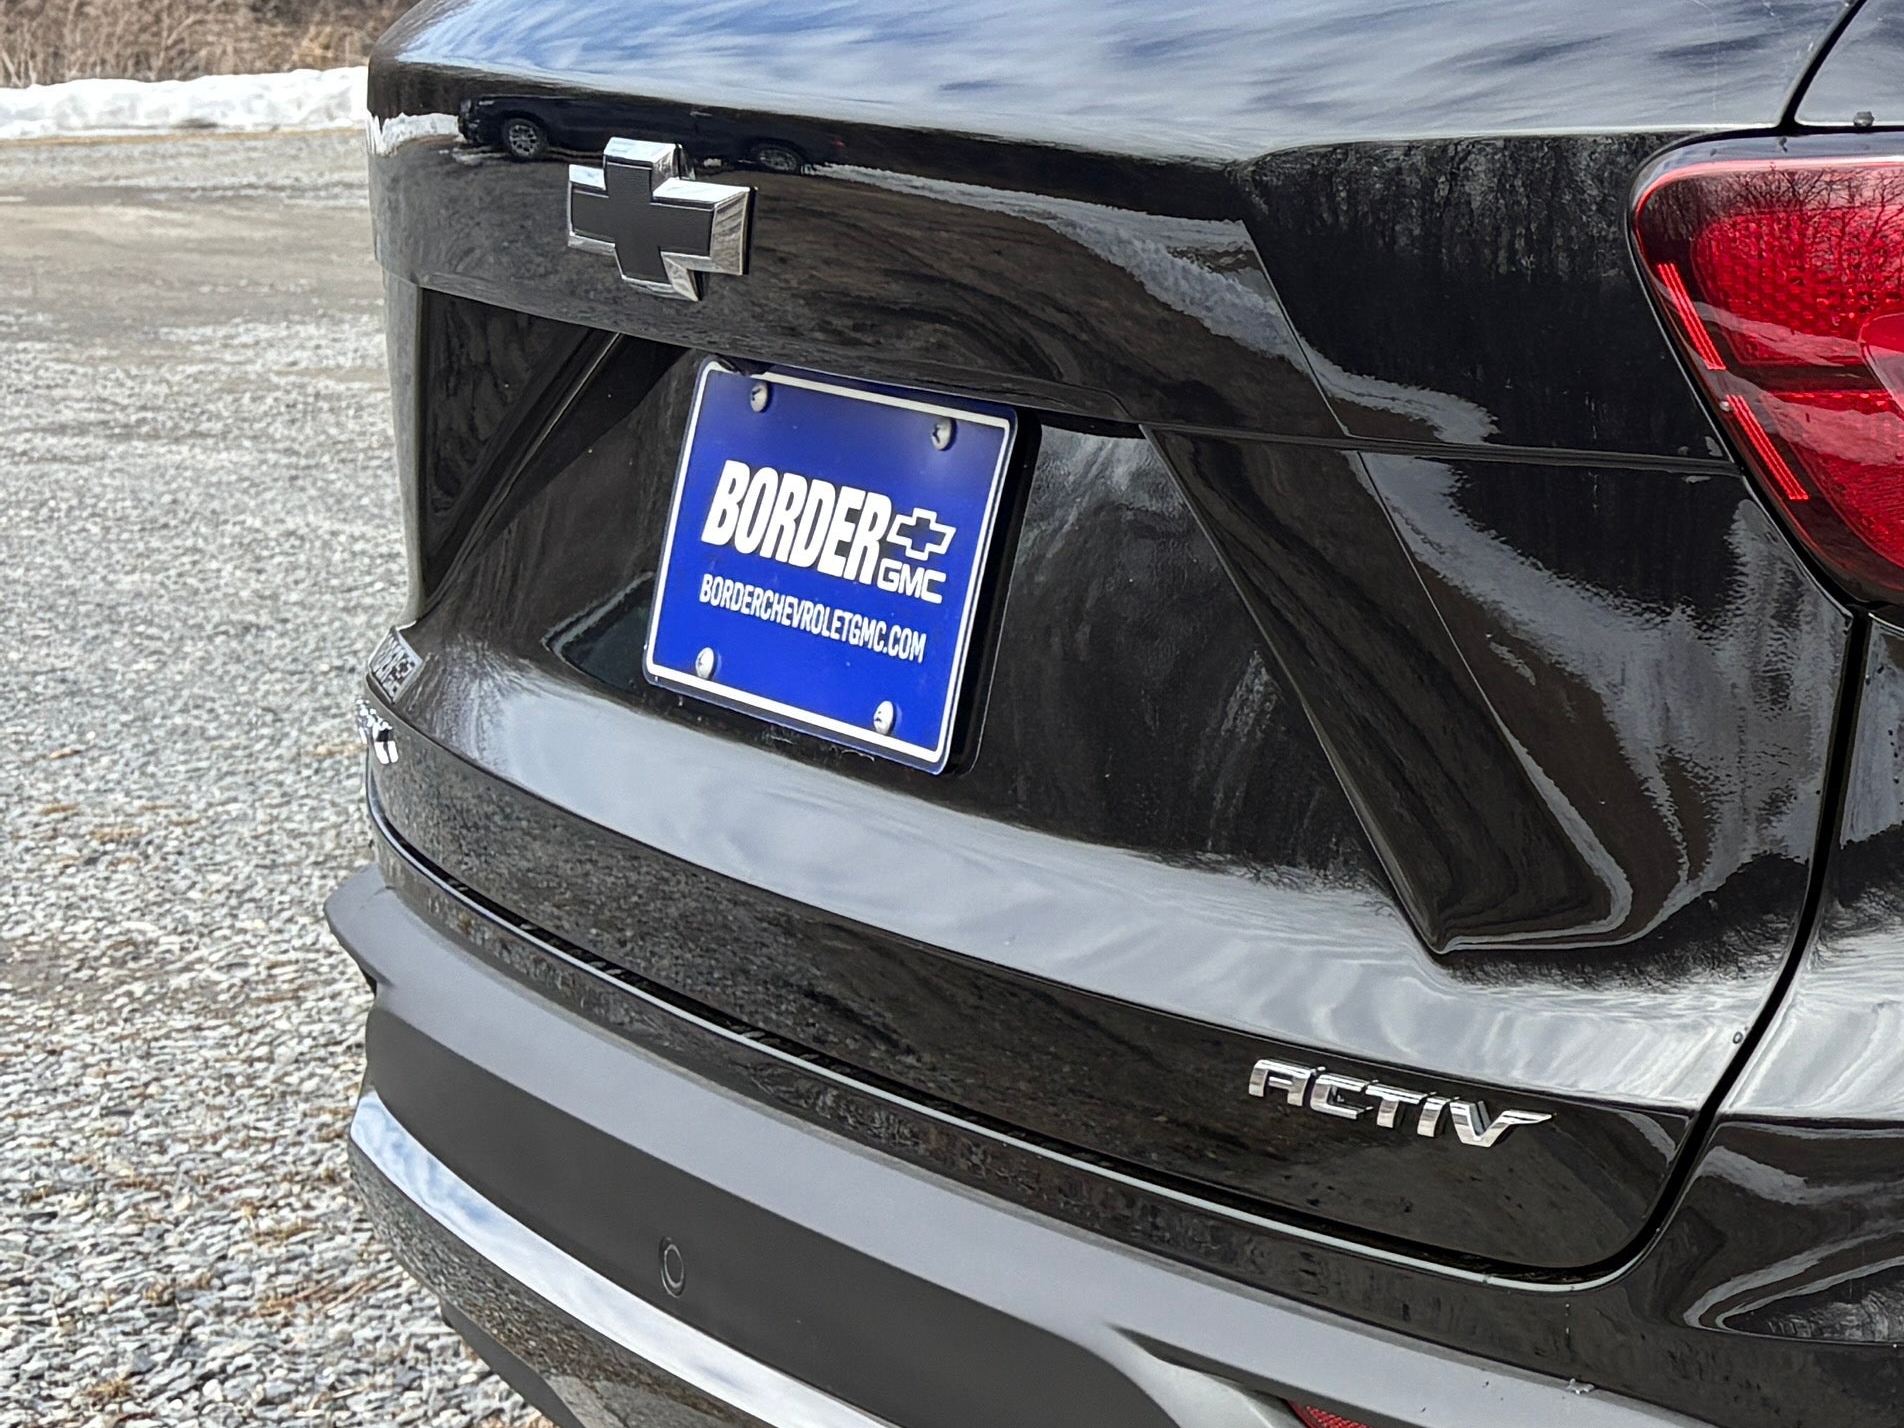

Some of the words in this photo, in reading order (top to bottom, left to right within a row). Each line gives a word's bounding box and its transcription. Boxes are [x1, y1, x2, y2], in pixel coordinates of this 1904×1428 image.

[702, 460, 892, 584] BORDER
[699, 573, 927, 663] BORDERCHEVROLETGMC.COM
[877, 560, 947, 604] GMC
[1248, 1058, 1553, 1148] ACTIV
